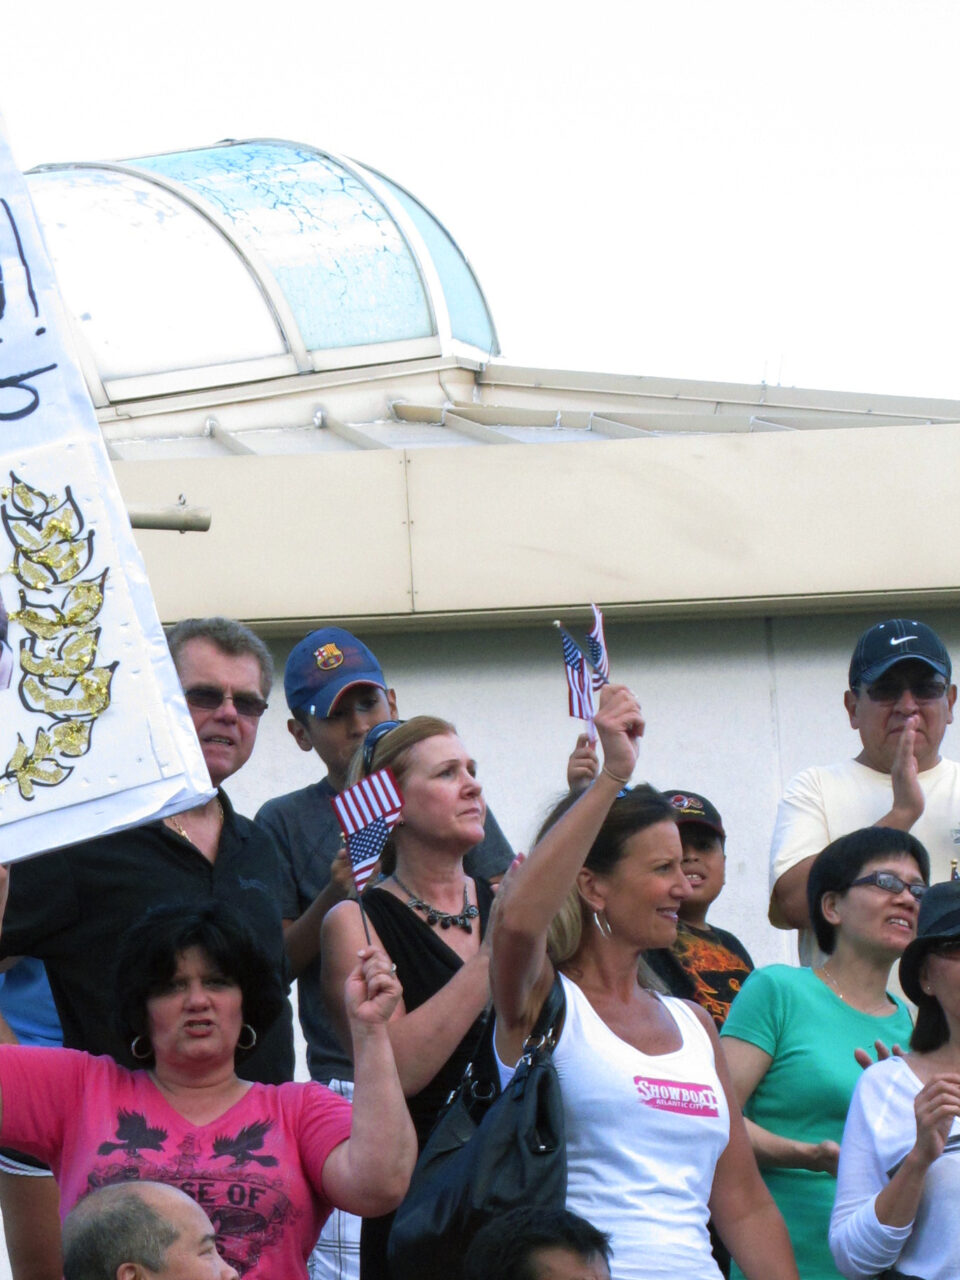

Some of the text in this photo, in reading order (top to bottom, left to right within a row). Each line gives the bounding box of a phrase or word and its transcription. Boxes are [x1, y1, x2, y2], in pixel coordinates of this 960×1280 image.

[637, 1080, 719, 1109] SHOWBOAT
[656, 1099, 705, 1110] ATLANTIC CITY
[227, 1183, 266, 1208] OF
